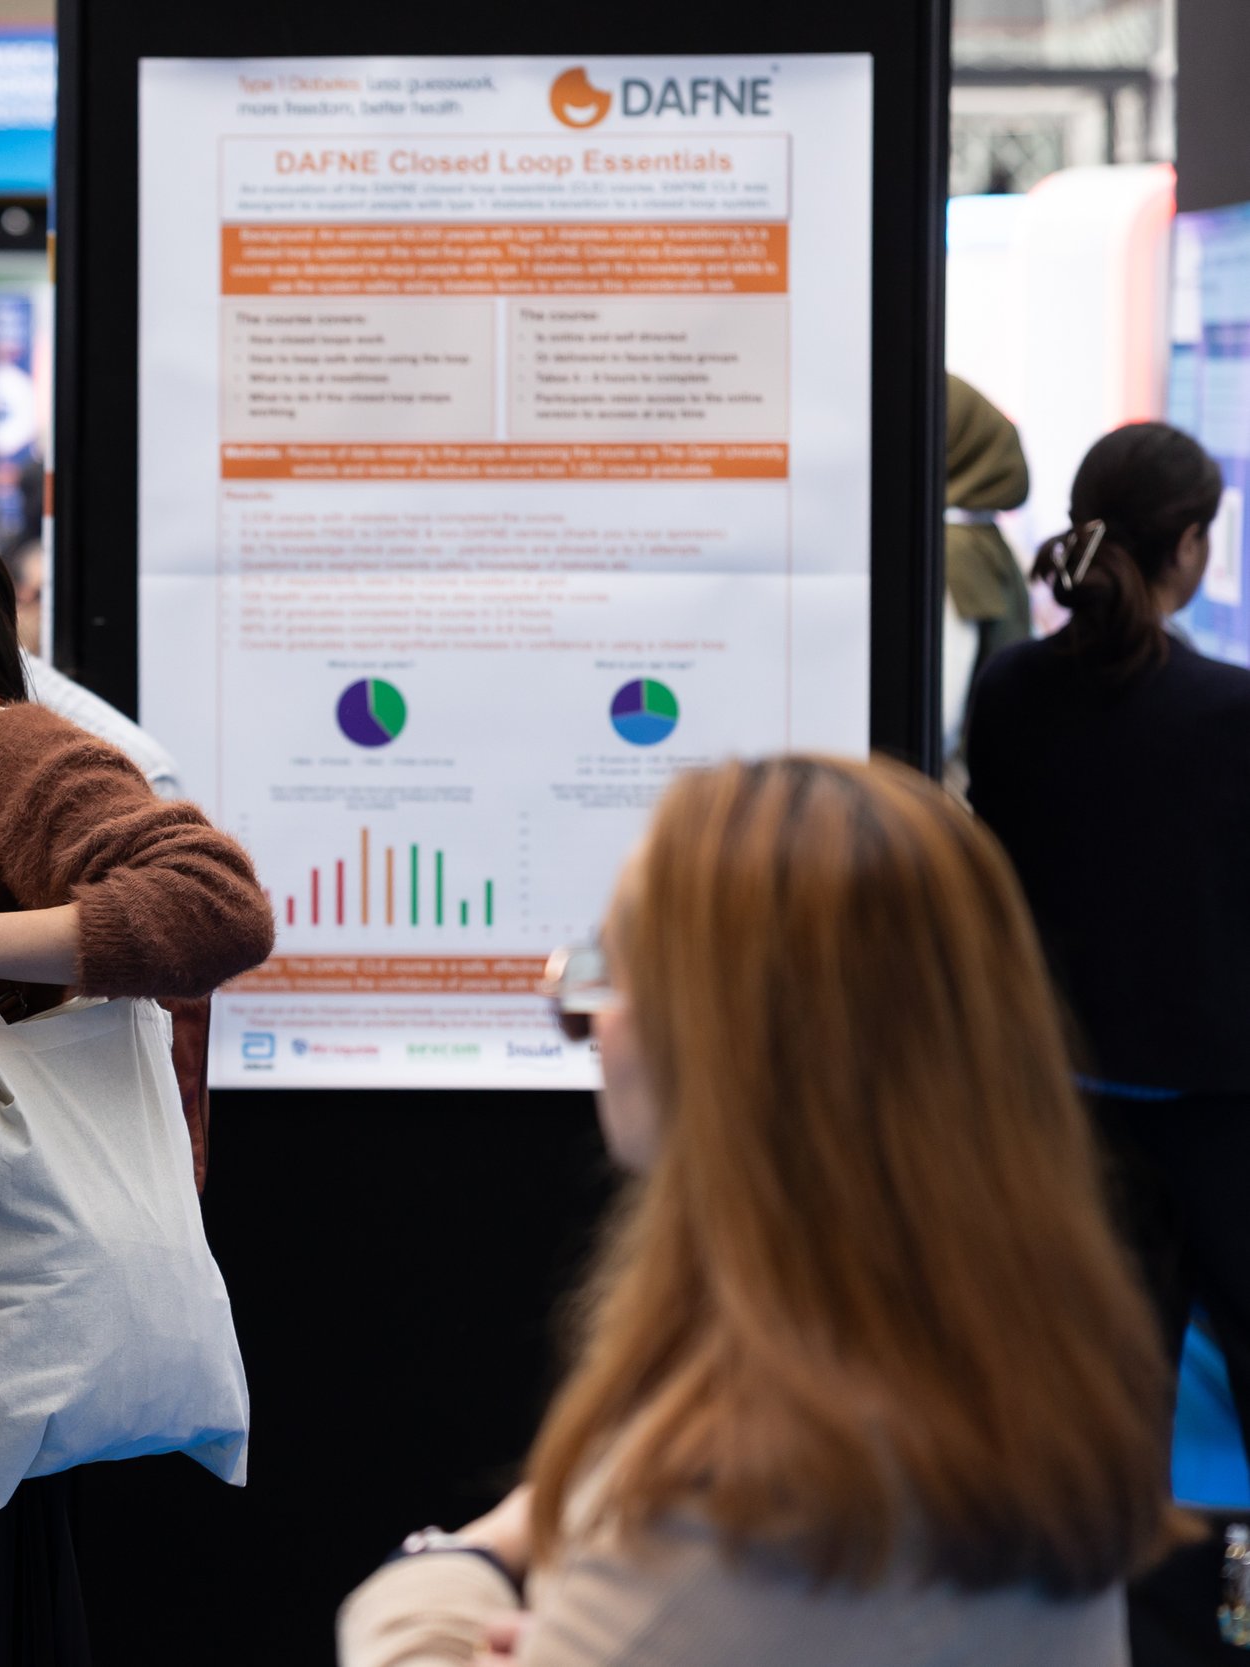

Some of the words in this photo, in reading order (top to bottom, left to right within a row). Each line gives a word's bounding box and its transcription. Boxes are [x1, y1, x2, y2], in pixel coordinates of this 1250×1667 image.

[620, 77, 772, 117] DAFNE
[360, 101, 407, 116] better
[275, 151, 380, 175] DAFNE
[388, 150, 489, 175] Closed
[500, 151, 572, 177] Loop
[583, 149, 733, 173] Essentials
[506, 1041, 563, 1058] Insulet
